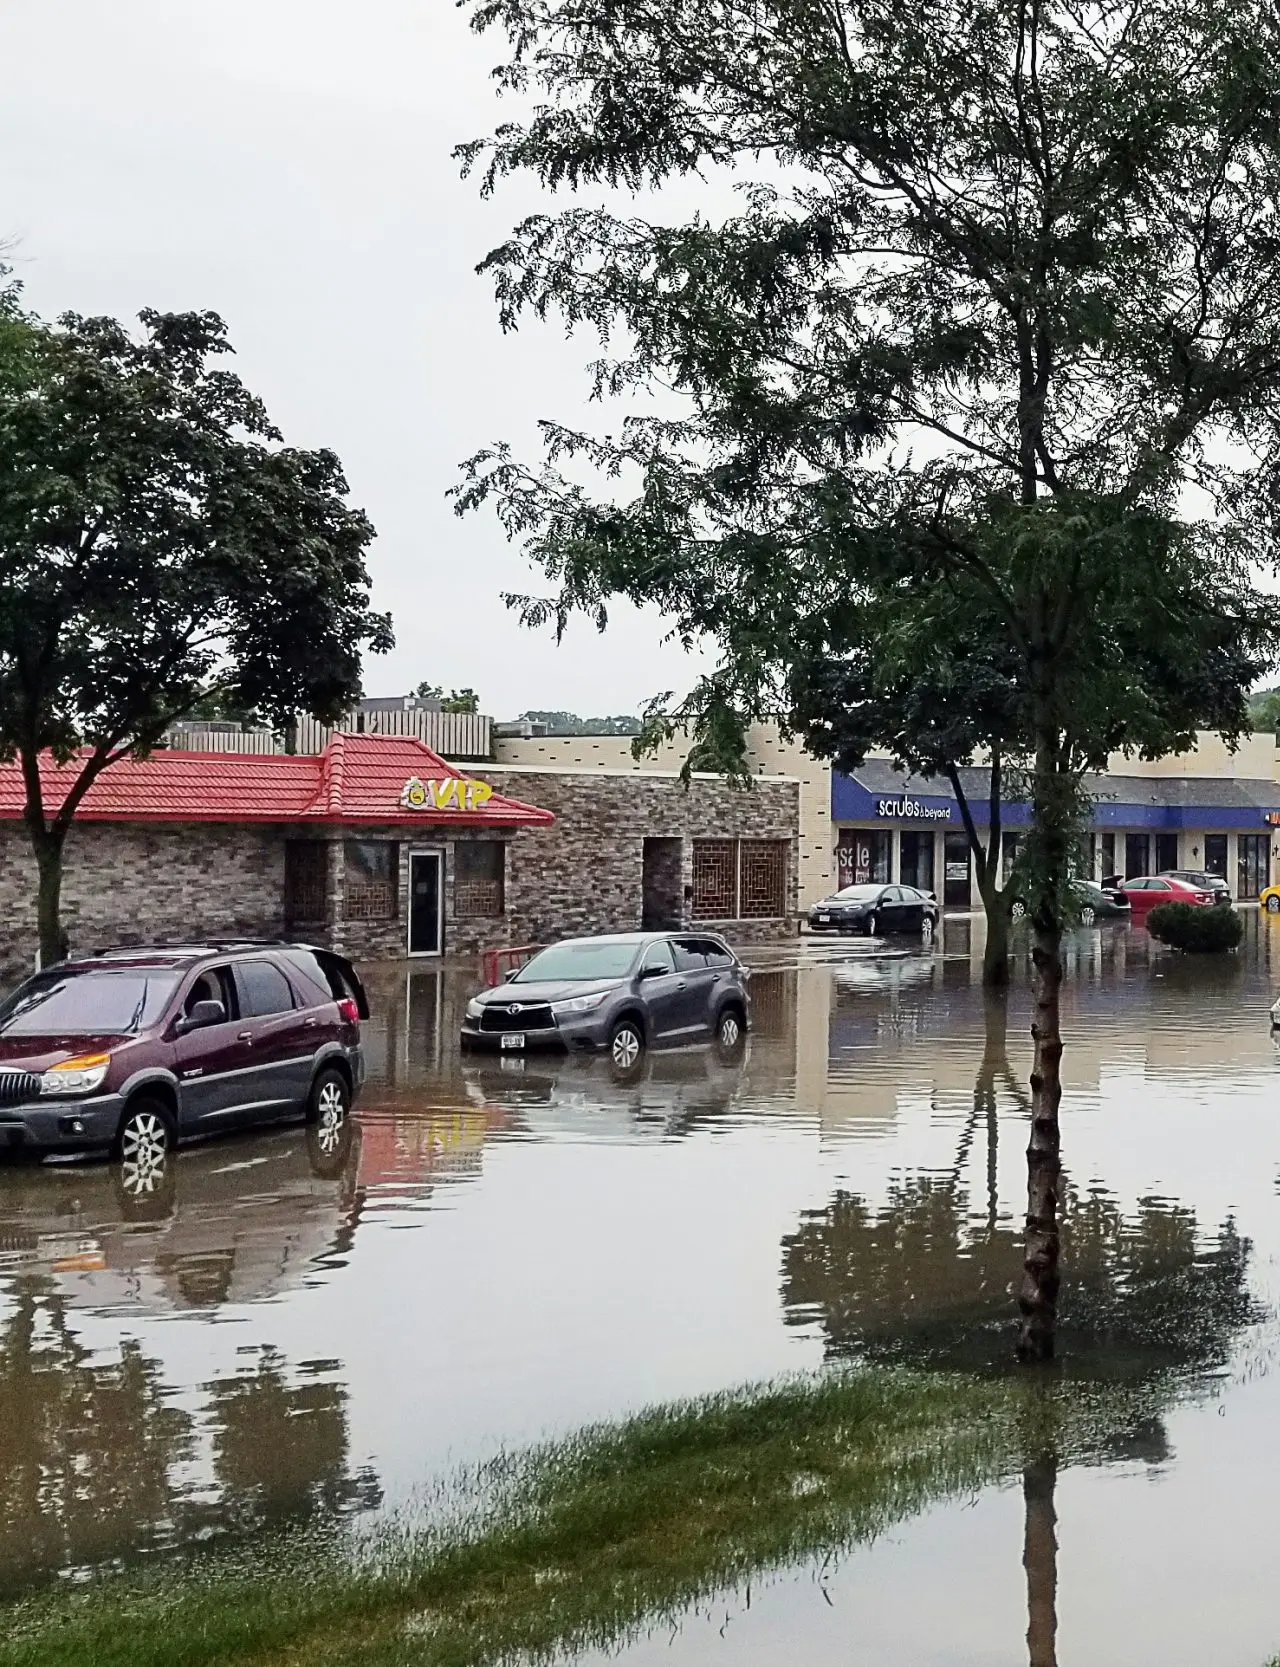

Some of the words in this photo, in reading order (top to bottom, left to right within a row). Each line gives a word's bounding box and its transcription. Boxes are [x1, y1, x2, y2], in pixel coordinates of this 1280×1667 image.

[428, 778, 493, 811] VIP
[879, 795, 920, 817] scrubs
[925, 805, 951, 820] beyond
